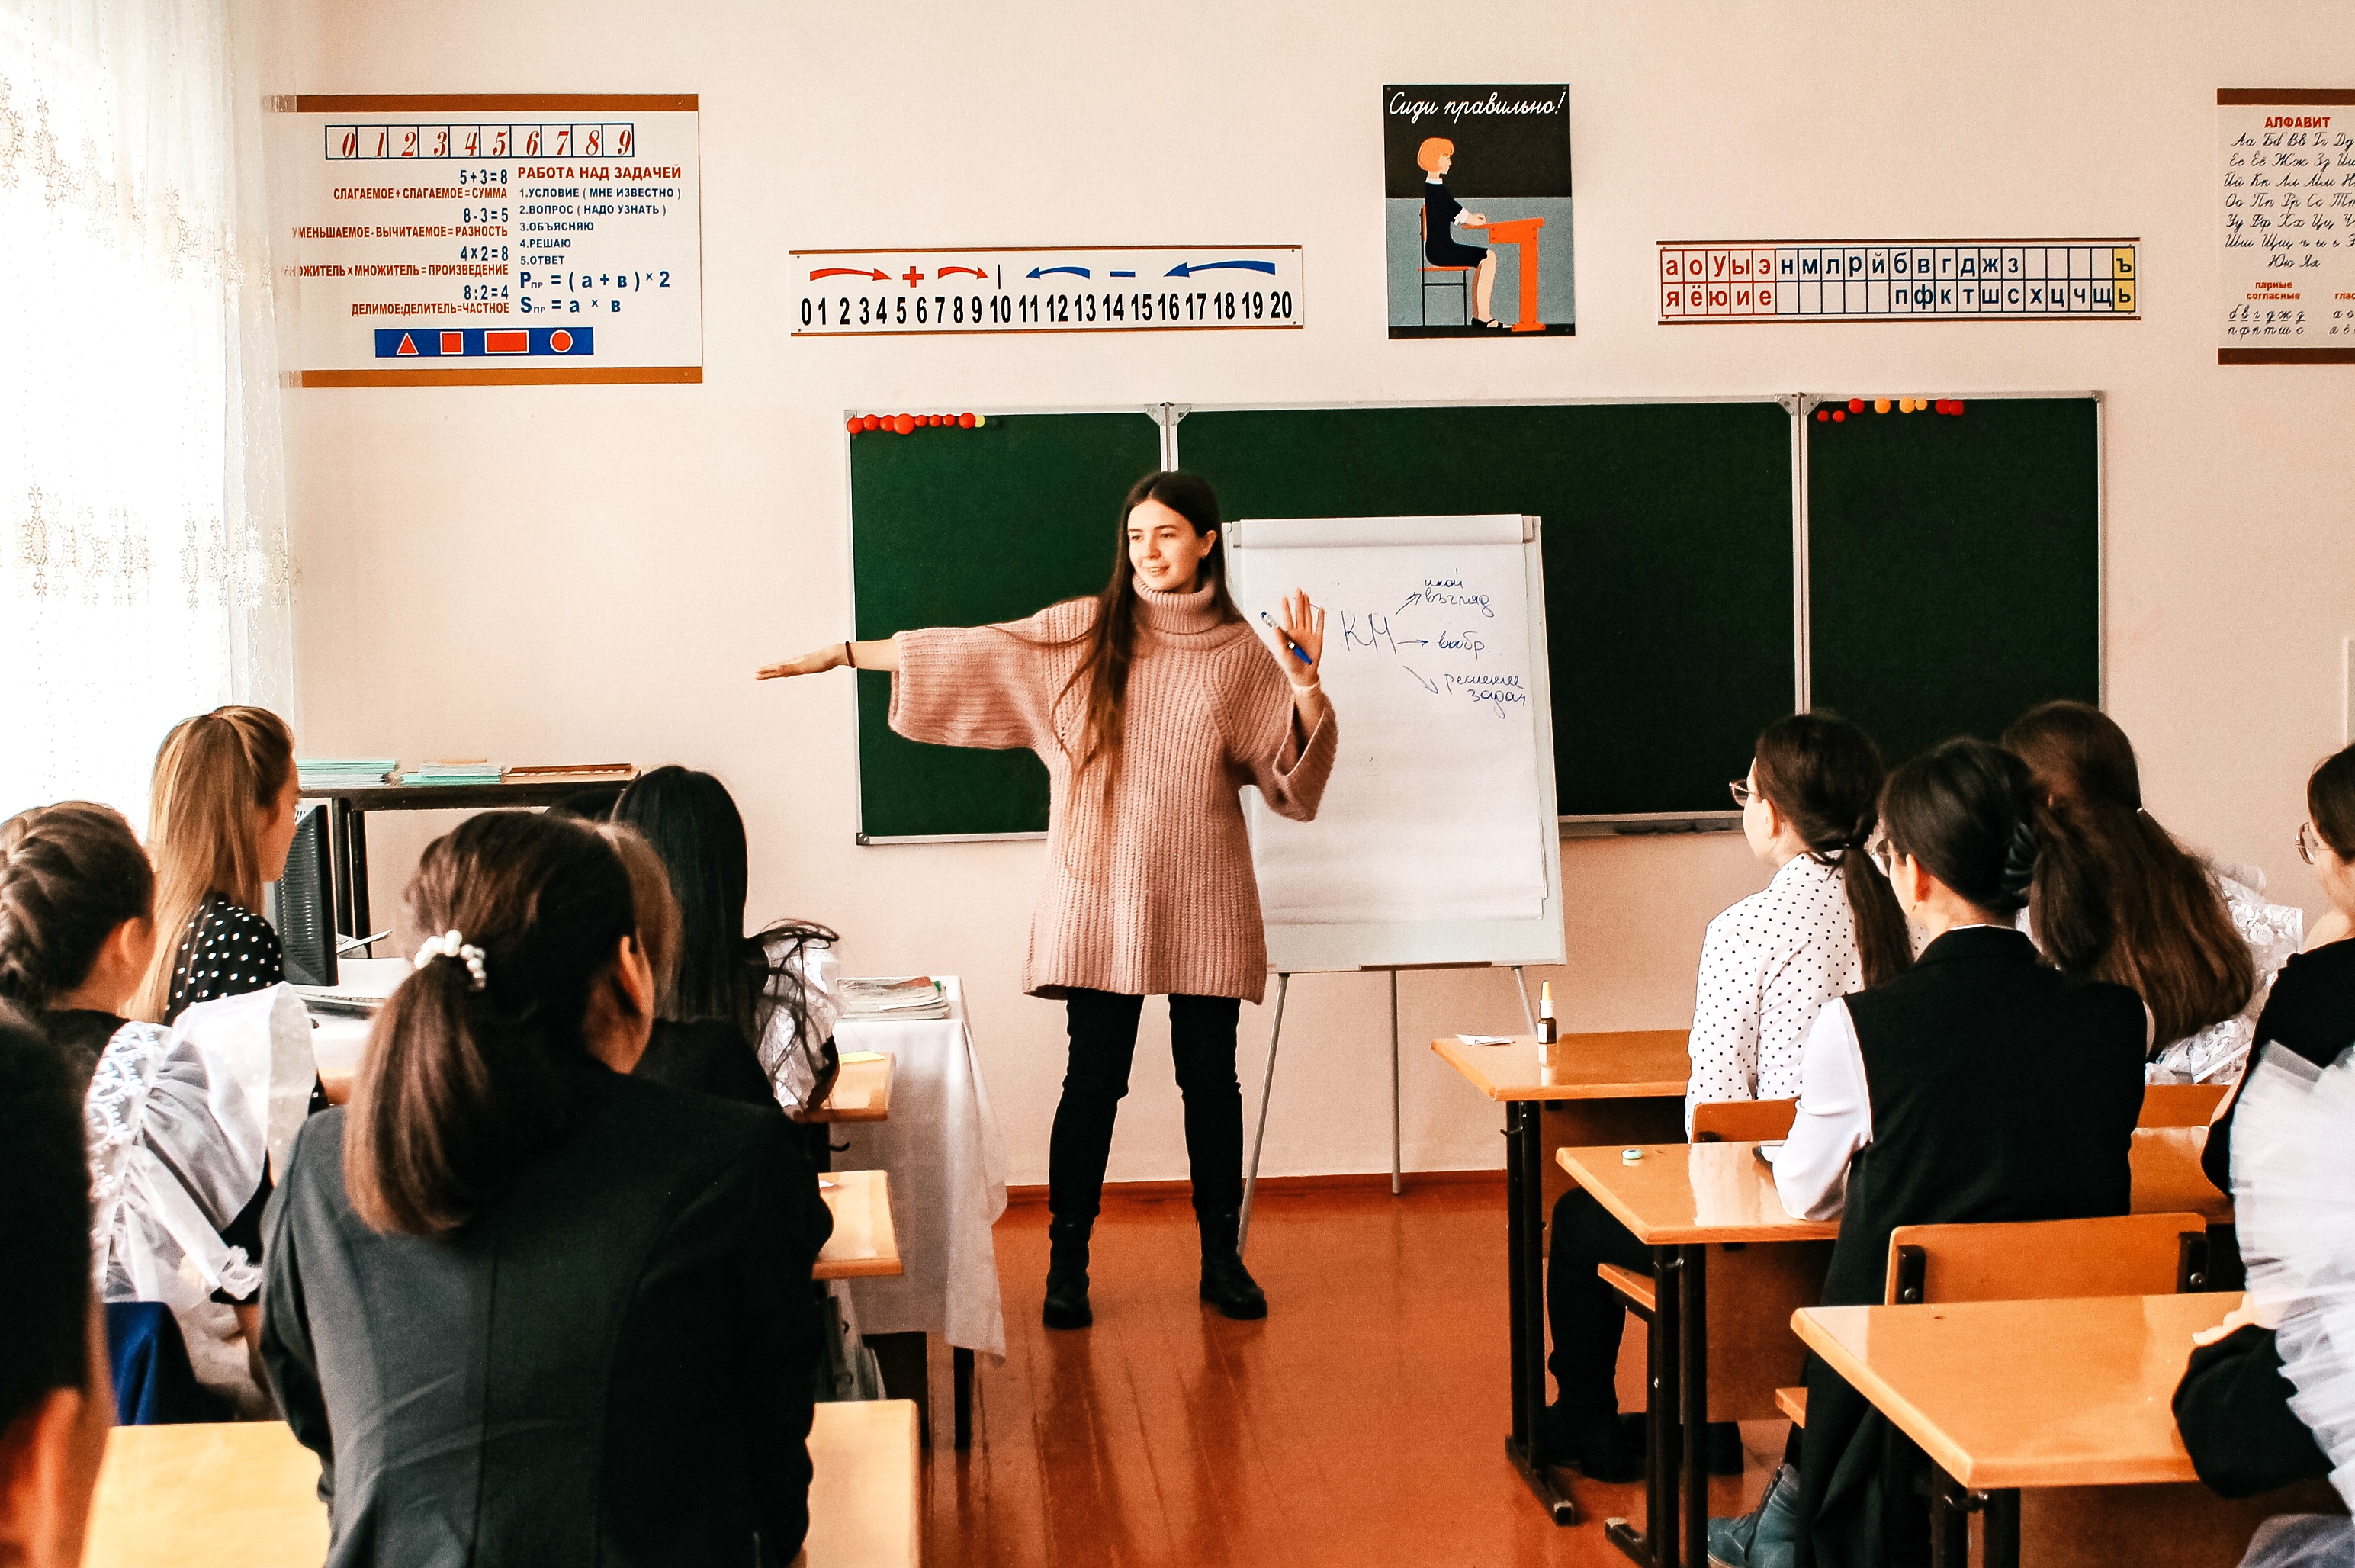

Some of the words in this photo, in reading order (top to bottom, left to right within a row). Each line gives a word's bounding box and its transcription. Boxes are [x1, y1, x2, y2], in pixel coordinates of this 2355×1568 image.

[1389, 92, 1438, 124] Сиди
[1444, 91, 1566, 124] правильно!
[2264, 117, 2331, 128] АЛФАВИТ
[342, 133, 355, 157] 0
[375, 133, 385, 156] 1
[401, 132, 416, 156] 2
[434, 132, 448, 156] 3
[464, 132, 477, 156] 4
[493, 132, 507, 156] 5
[526, 131, 539, 156] 6
[557, 131, 569, 155] 7
[586, 130, 600, 156] 8
[618, 130, 631, 155] 9
[518, 167, 574, 179] РАБОТА
[580, 167, 609, 181] НАД
[615, 164, 681, 181] ЗАДАЧЕЙ
[520, 188, 579, 198] 1.УСЛОВИЕ
[519, 205, 573, 214] 2.ВОПРОС
[520, 222, 593, 231] 3.ОБЪЯСНЯЮ
[520, 239, 571, 248] 4.РЕШАЮ
[520, 256, 564, 265] 5.ОТВЕТ
[2255, 281, 2292, 291] парные
[802, 298, 811, 326] 0
[818, 298, 826, 325] 1
[840, 297, 850, 325] 2
[859, 297, 869, 324] 3
[876, 297, 887, 323] 4
[896, 297, 906, 324] 5
[917, 296, 927, 323] 6
[935, 297, 945, 323] 7
[953, 296, 963, 323] 8
[972, 296, 982, 323] 9
[990, 296, 1011, 323] 10
[1019, 295, 1038, 323] 11
[1046, 294, 1068, 322] 12
[1075, 294, 1096, 322] 13
[1102, 294, 1124, 321] 14
[1131, 294, 1152, 321] 15
[1158, 293, 1179, 320] 16
[1186, 293, 1206, 320] 17
[1213, 292, 1235, 320] 18
[1242, 292, 1263, 319] 19
[1271, 291, 1292, 318] 20
